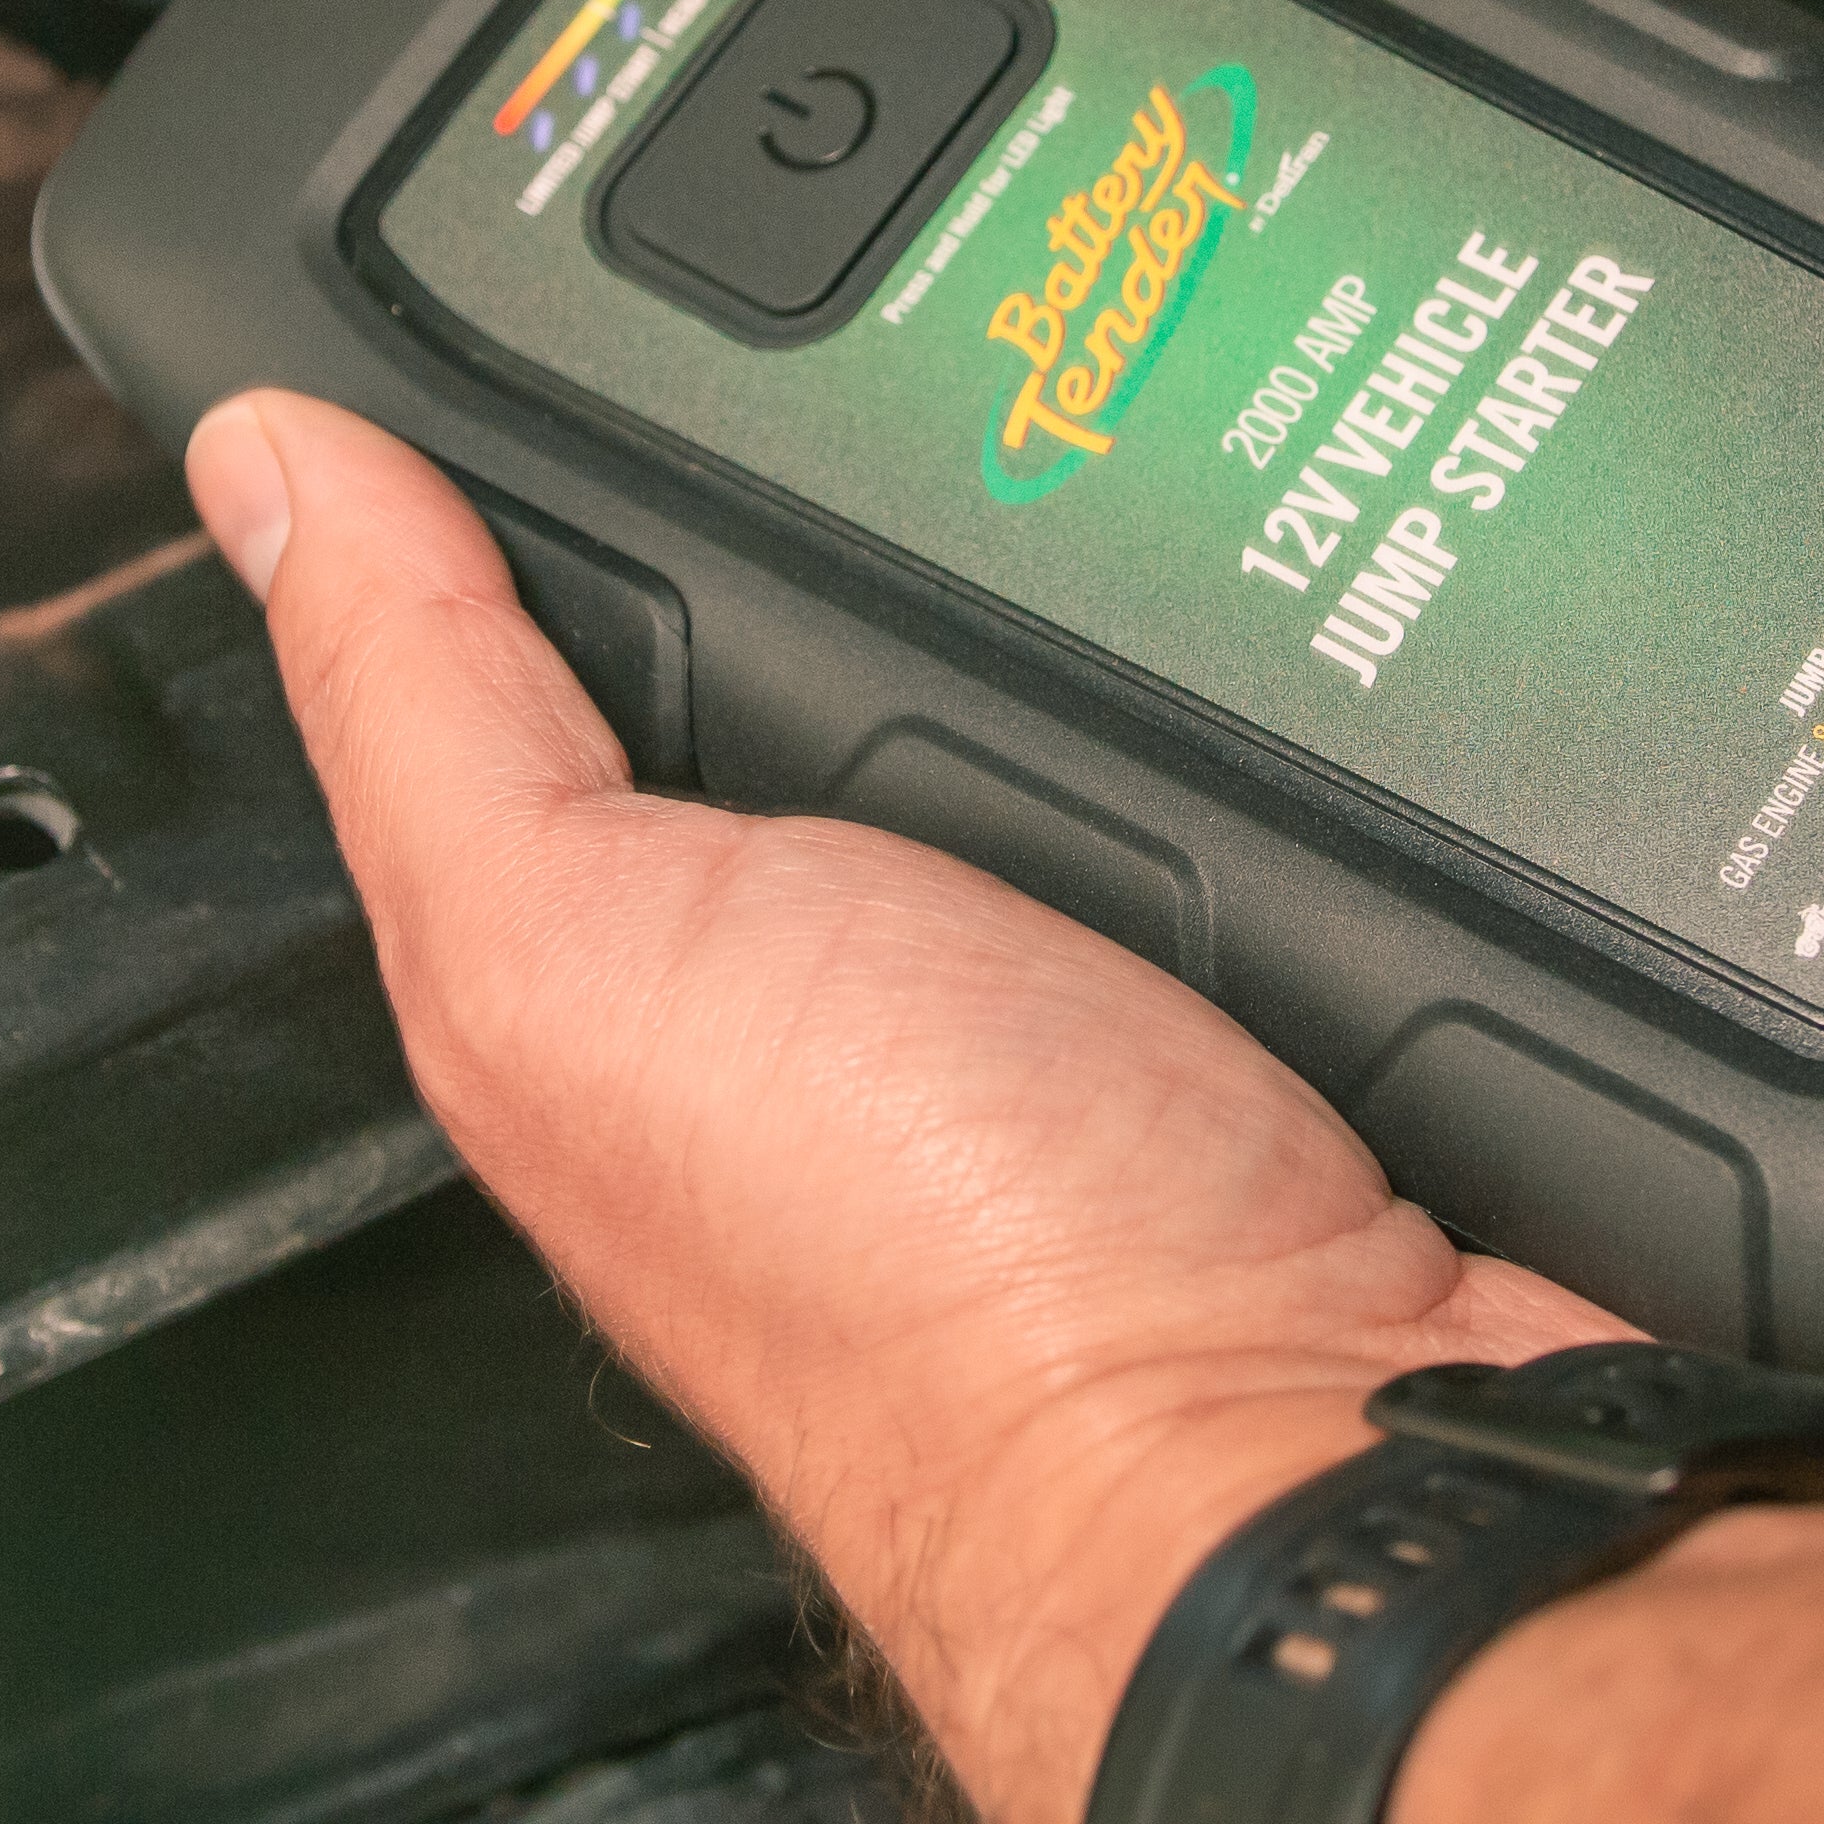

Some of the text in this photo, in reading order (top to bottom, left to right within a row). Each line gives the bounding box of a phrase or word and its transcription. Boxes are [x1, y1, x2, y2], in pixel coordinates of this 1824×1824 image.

[986, 84, 1187, 375] Battery
[1002, 160, 1248, 455] Tender
[1221, 274, 1378, 471] 2000 AMP
[1241, 231, 1540, 592] 12V VEHICLE
[1309, 254, 1656, 689] JUMP STARTER
[1719, 836, 1769, 889] GAS
